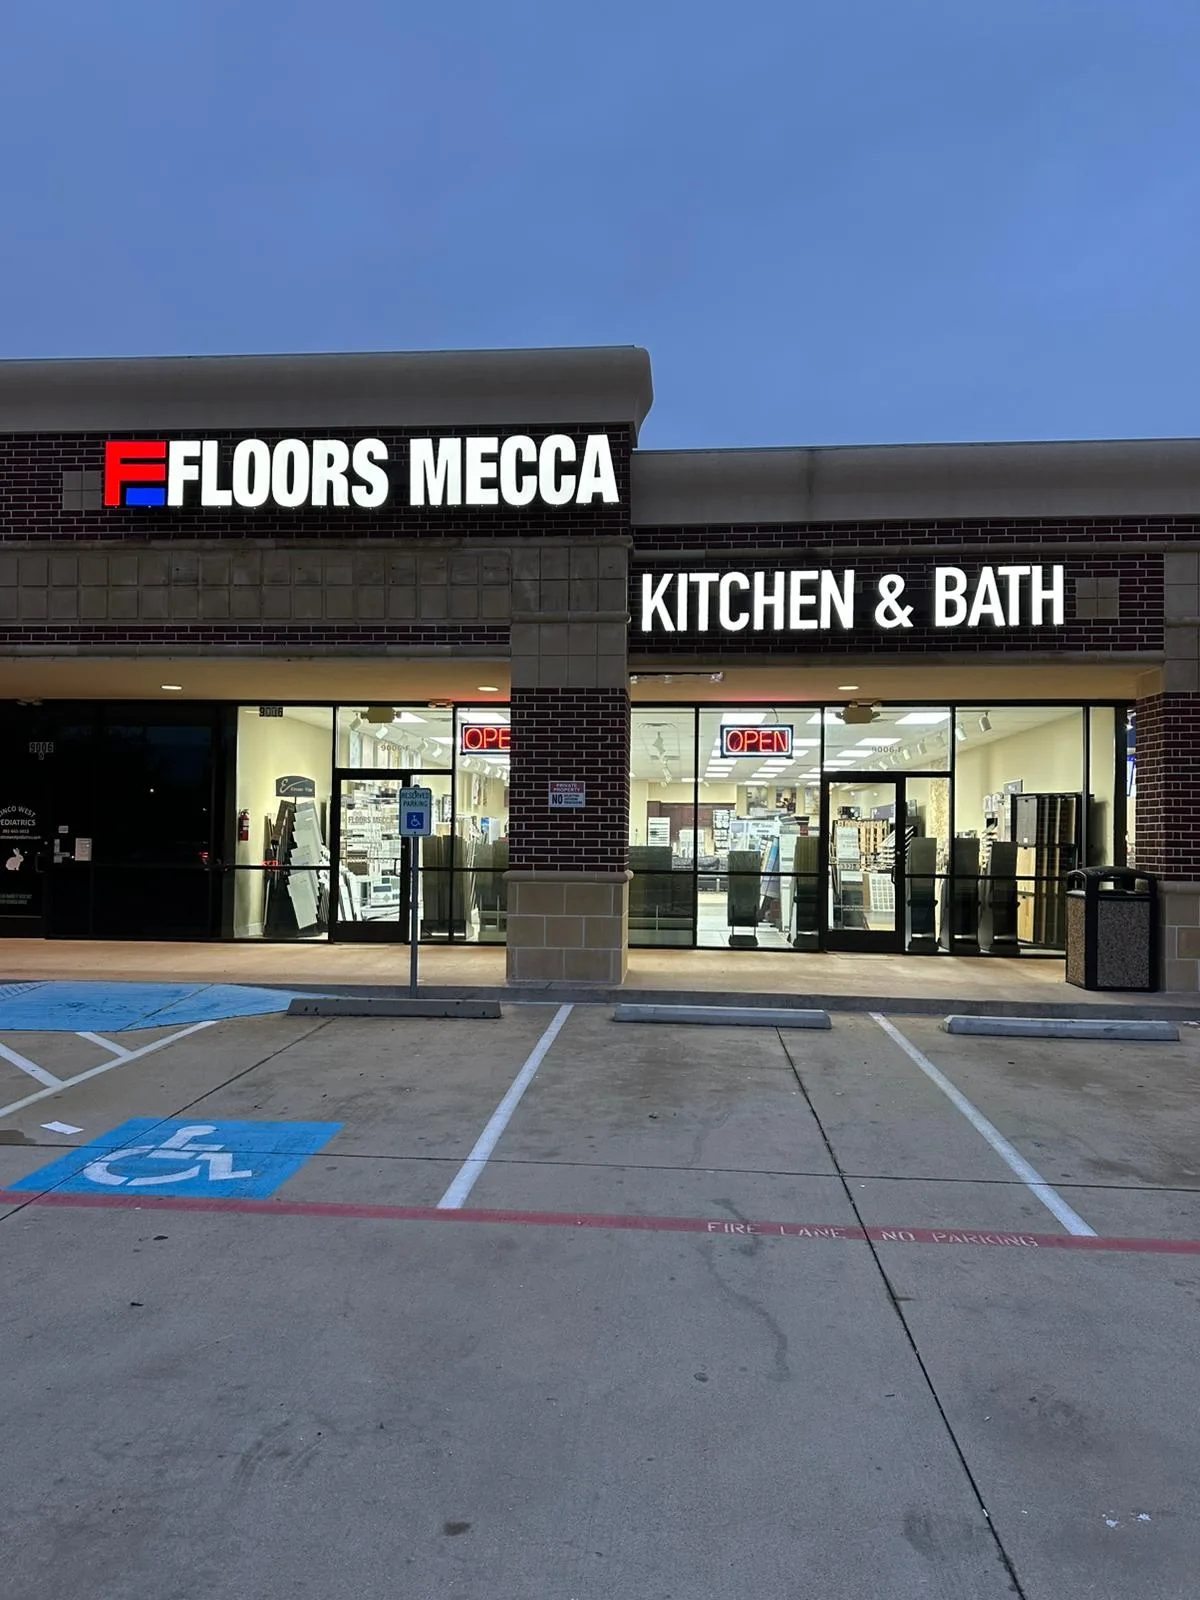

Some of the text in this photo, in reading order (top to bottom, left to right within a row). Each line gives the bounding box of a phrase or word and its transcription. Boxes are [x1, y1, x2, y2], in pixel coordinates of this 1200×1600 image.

[168, 435, 619, 507] FLOORS MECCA
[642, 565, 1063, 631] KITCHEN & BATH
[465, 727, 511, 749] OPE
[726, 729, 789, 753] OPEN
[401, 791, 429, 799] RESERVED
[552, 794, 563, 805] NO
[18, 805, 36, 817] WEST
[707, 1222, 1039, 1247] FIRE LANE NO PARKING
